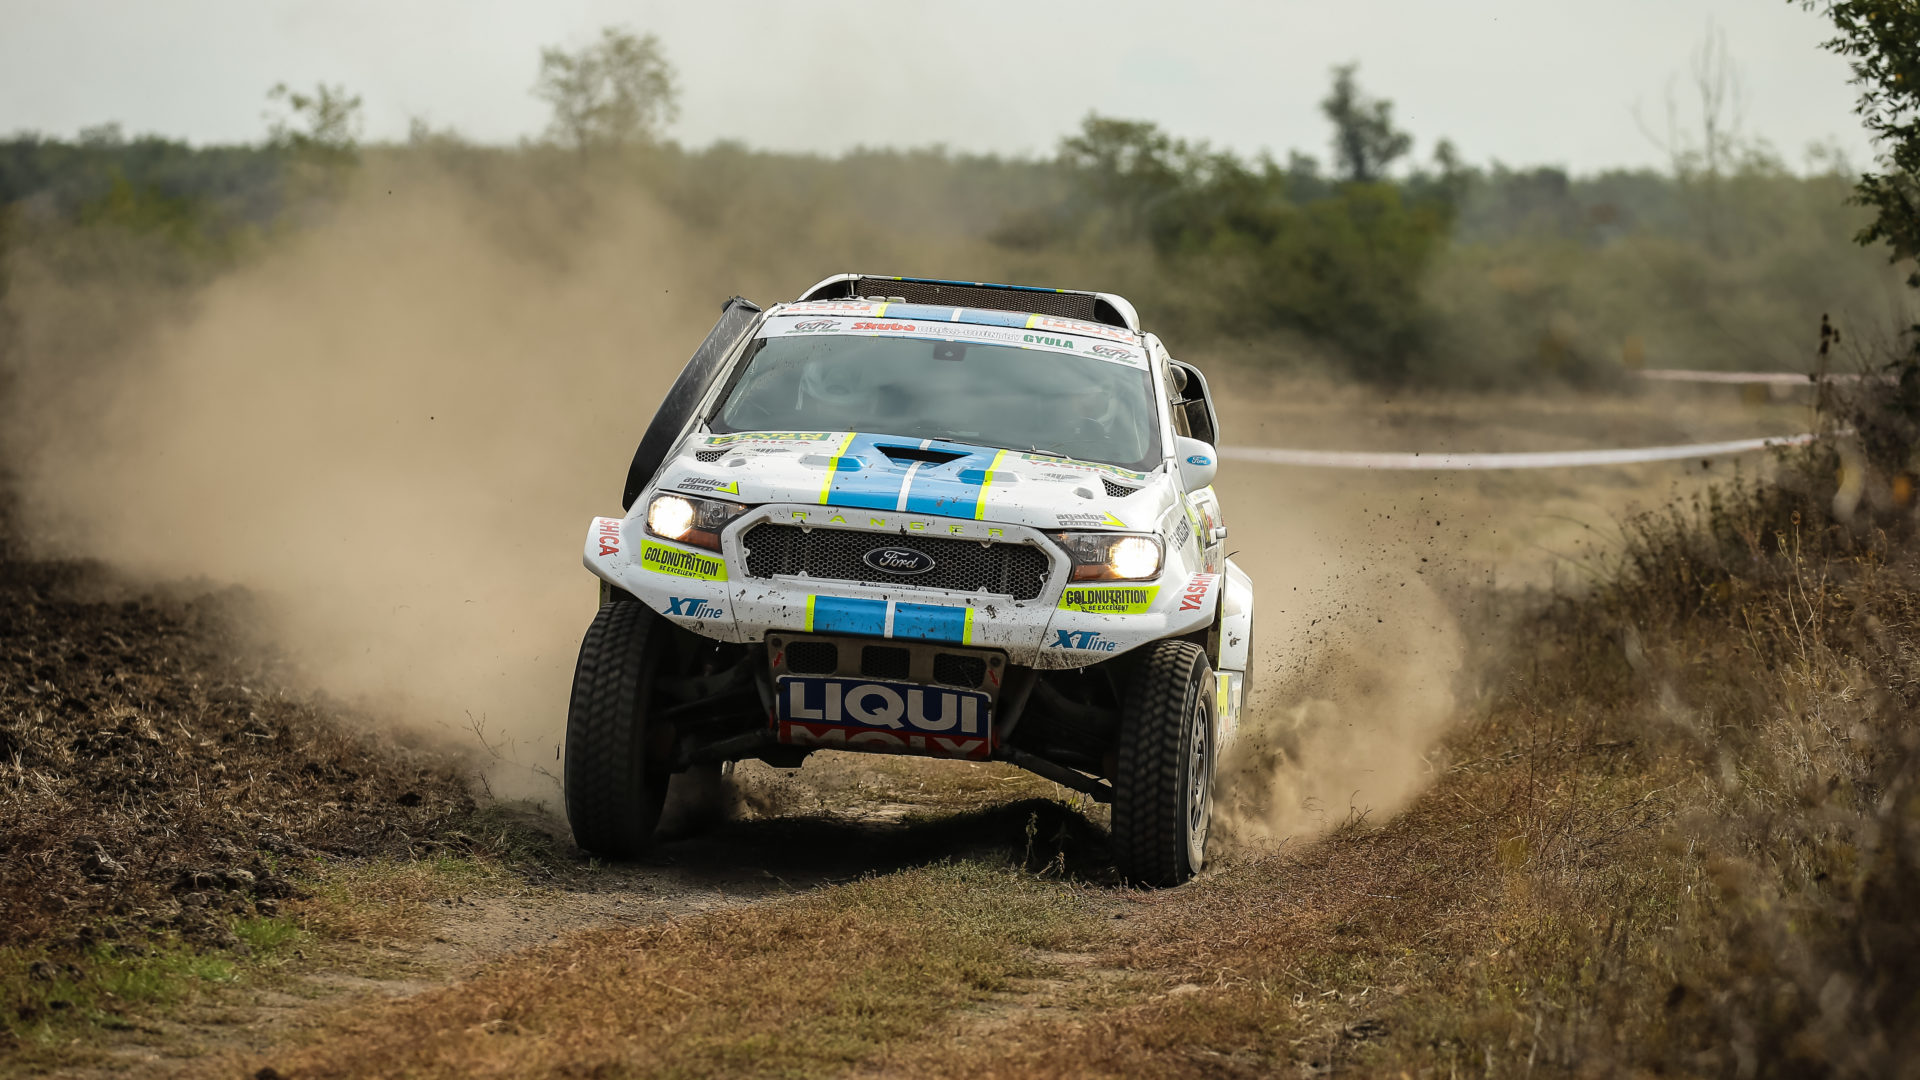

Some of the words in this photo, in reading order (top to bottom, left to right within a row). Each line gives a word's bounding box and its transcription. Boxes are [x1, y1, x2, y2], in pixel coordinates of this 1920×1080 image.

[1023, 334, 1074, 349] GYULA
[683, 476, 729, 488] agados
[791, 511, 1004, 537] RANGER
[644, 546, 720, 577] GOLDNUTRITION
[879, 550, 918, 569] Ford
[667, 566, 697, 578] EXCELLENT
[1066, 589, 1148, 606] GOLDNUTRITION
[1049, 629, 1116, 651] XTline
[789, 682, 978, 734] LIQUI
